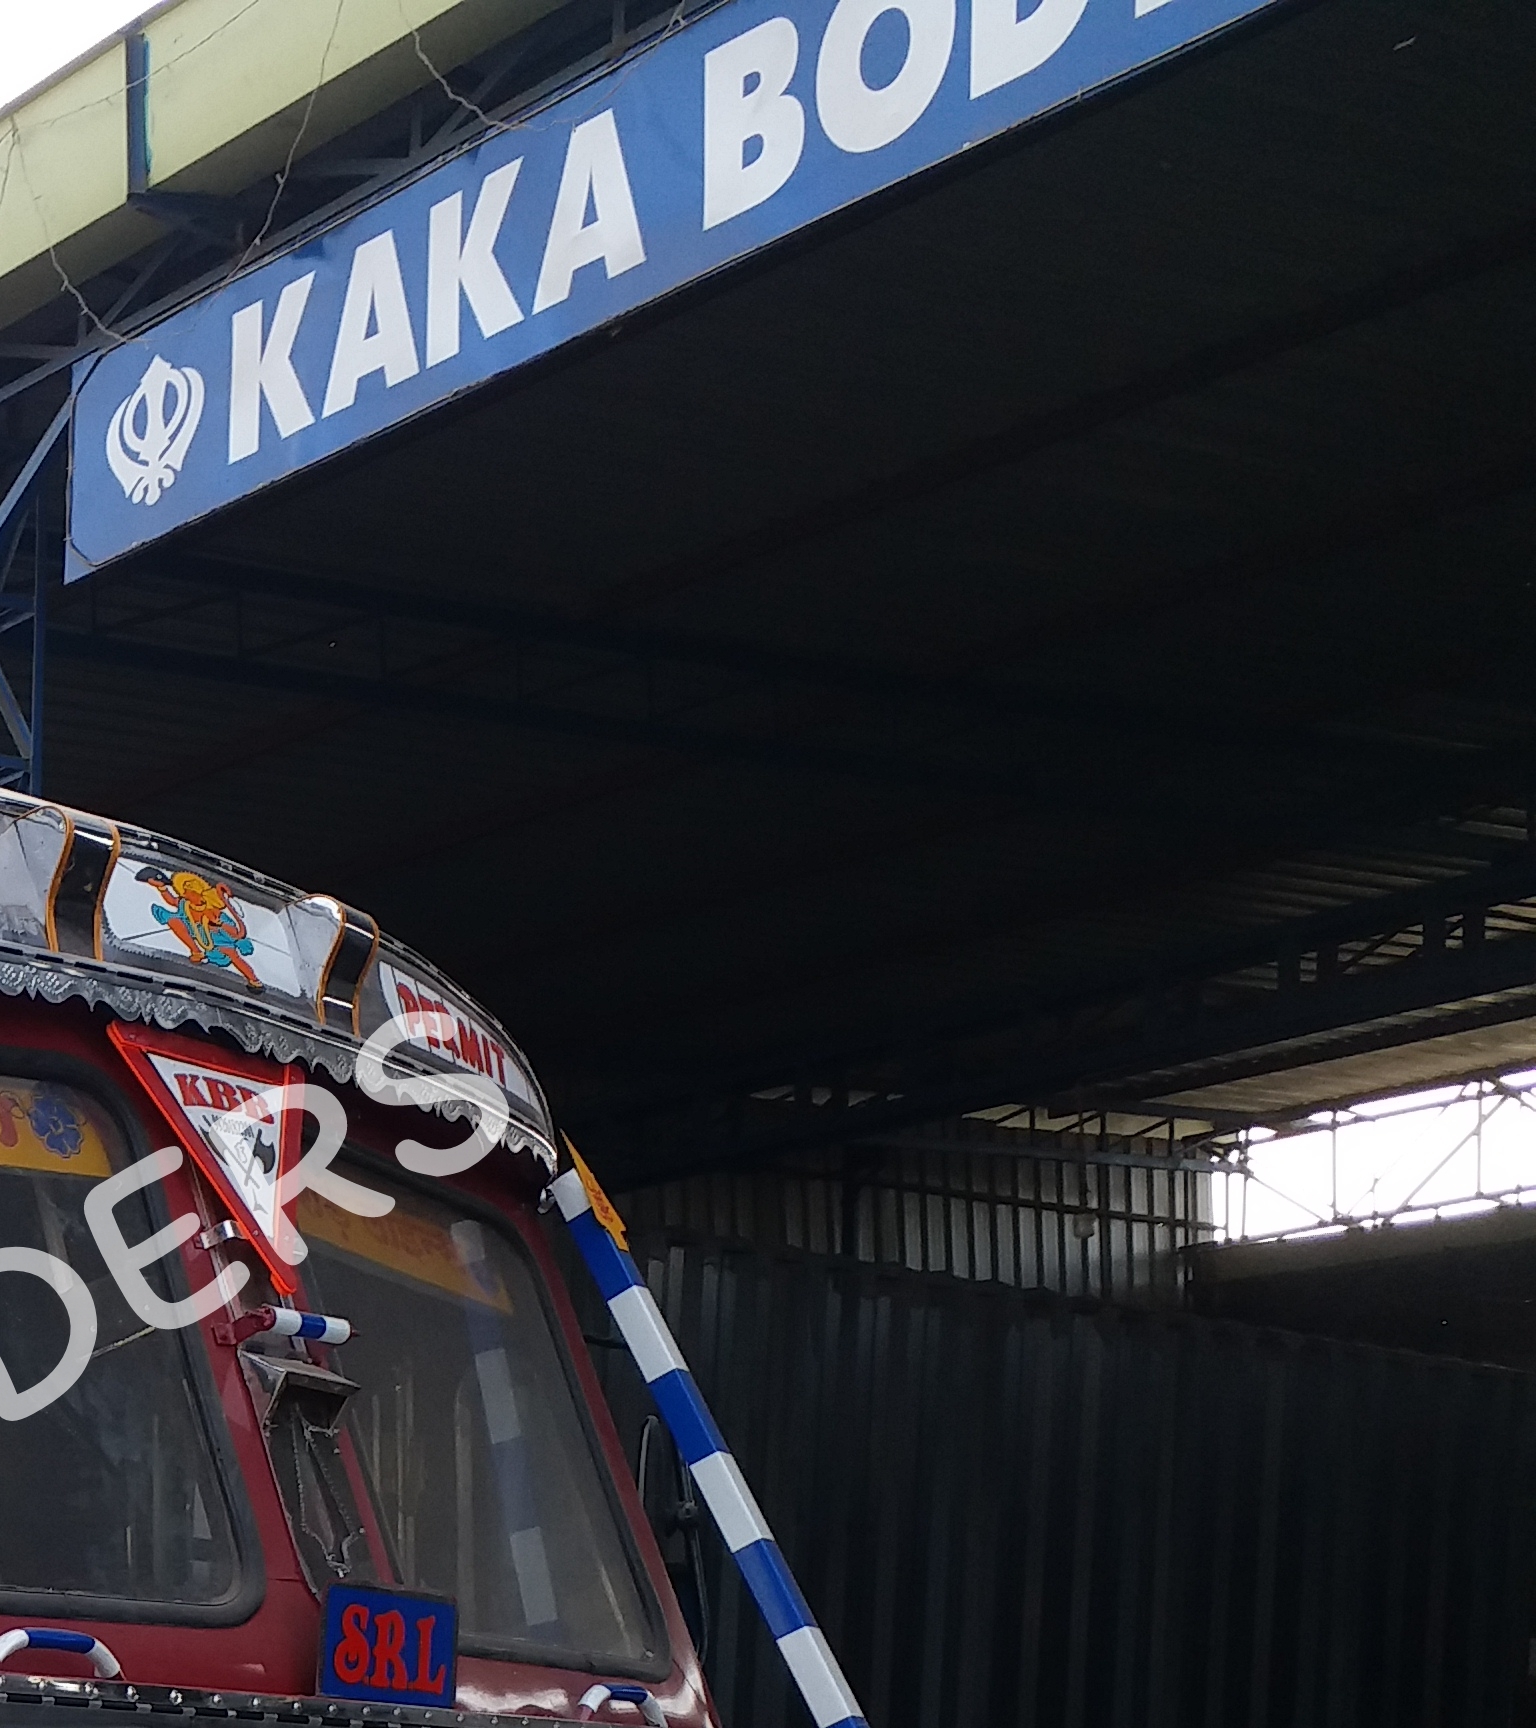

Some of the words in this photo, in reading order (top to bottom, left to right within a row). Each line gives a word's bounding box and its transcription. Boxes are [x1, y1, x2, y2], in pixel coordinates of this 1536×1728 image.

[228, 107, 646, 466] KAKA
[703, 0, 1174, 231] BOD
[396, 981, 507, 1088] PERMIT
